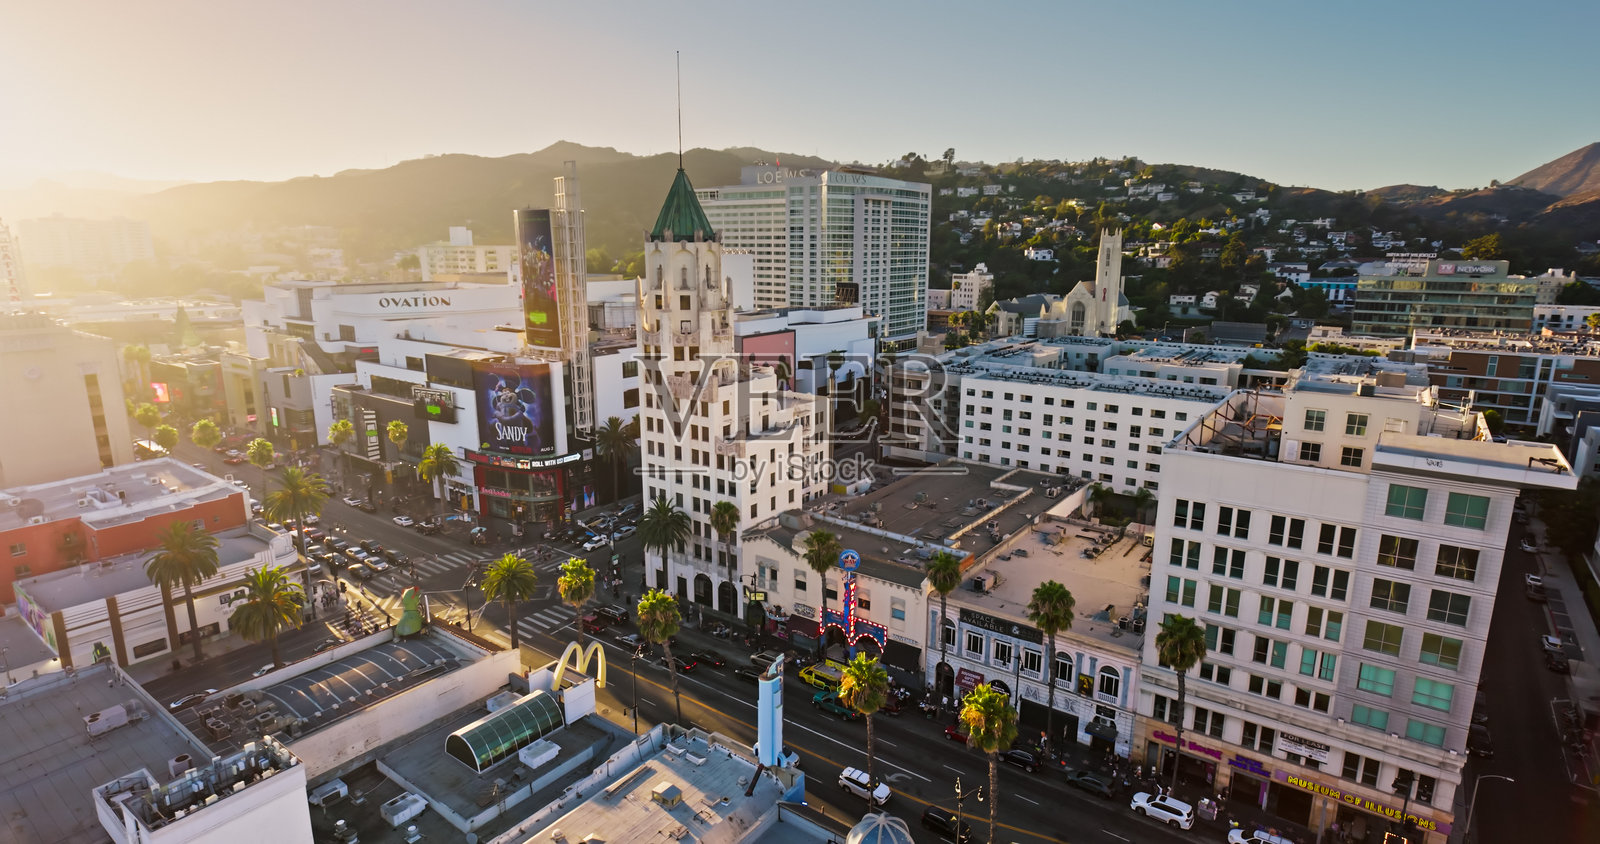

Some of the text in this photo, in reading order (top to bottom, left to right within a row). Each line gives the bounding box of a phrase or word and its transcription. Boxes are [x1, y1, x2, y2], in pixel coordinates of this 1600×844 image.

[757, 169, 805, 184] LOEWS
[829, 173, 868, 185] LOEWS
[1457, 265, 1496, 273] NETWORK
[379, 293, 451, 308] OVATION
[495, 422, 528, 442] SANDY
[963, 616, 1004, 633] AVAILABLE
[971, 612, 995, 624] SPACE
[1283, 732, 1325, 749] FOR LEASE
[1287, 775, 1340, 799] MUSEUM
[1344, 794, 1361, 806] OF
